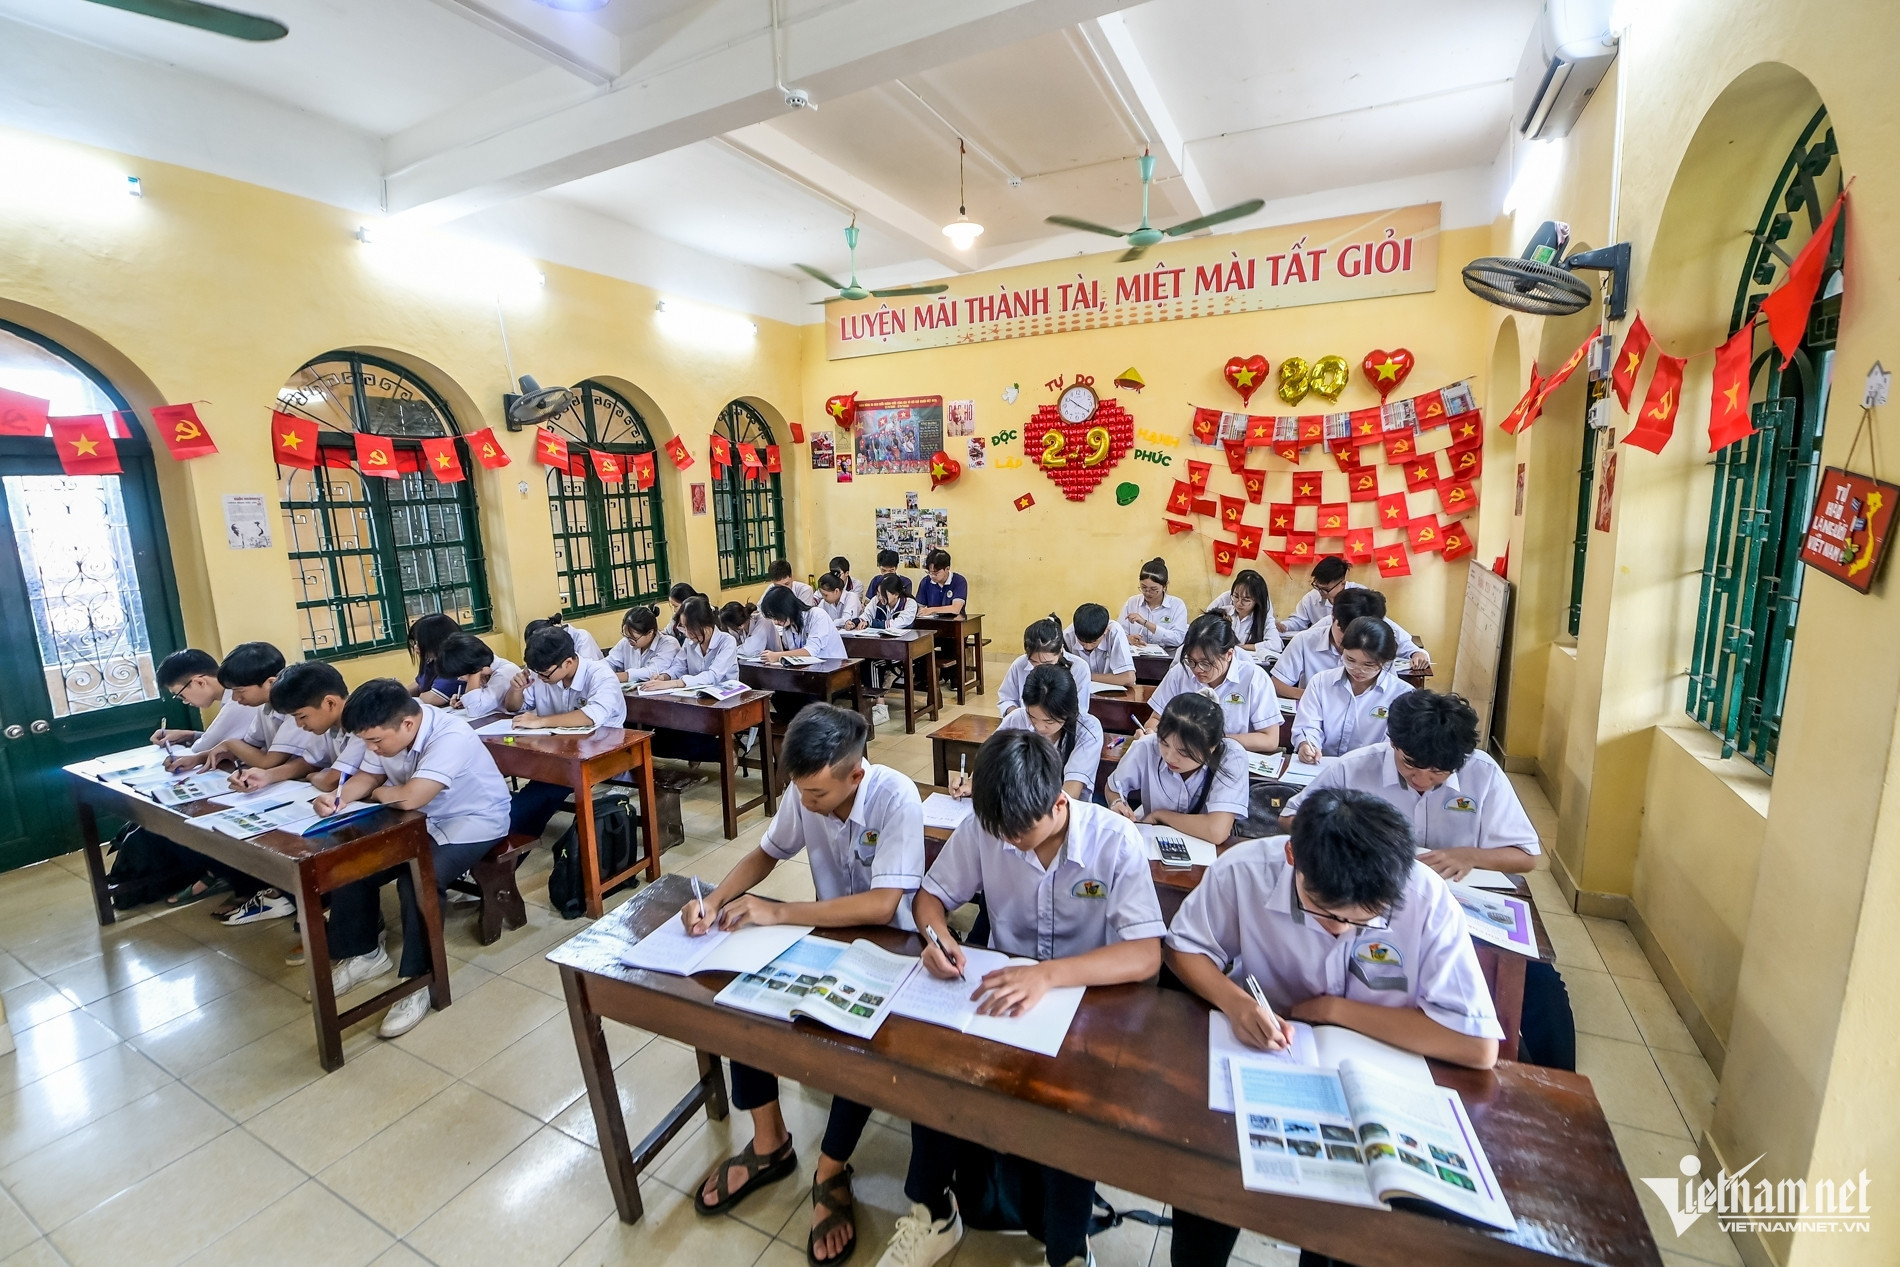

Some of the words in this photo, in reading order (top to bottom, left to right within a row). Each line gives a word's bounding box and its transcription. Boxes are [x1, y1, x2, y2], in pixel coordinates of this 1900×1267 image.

[840, 304, 906, 342] LUYỆN
[914, 296, 958, 331] MÃI
[964, 285, 1049, 324] THÀNH
[1057, 273, 1106, 312] TÀI,
[1115, 261, 1186, 308] MIỆT
[1194, 251, 1255, 296] MÀI
[1266, 236, 1327, 286] TẤT
[1336, 227, 1413, 278] GIỎI
[1044, 373, 1064, 392] TỰ
[1075, 373, 1095, 387] DO
[991, 429, 1018, 446] ĐỘC
[1133, 449, 1173, 467] PHÚC
